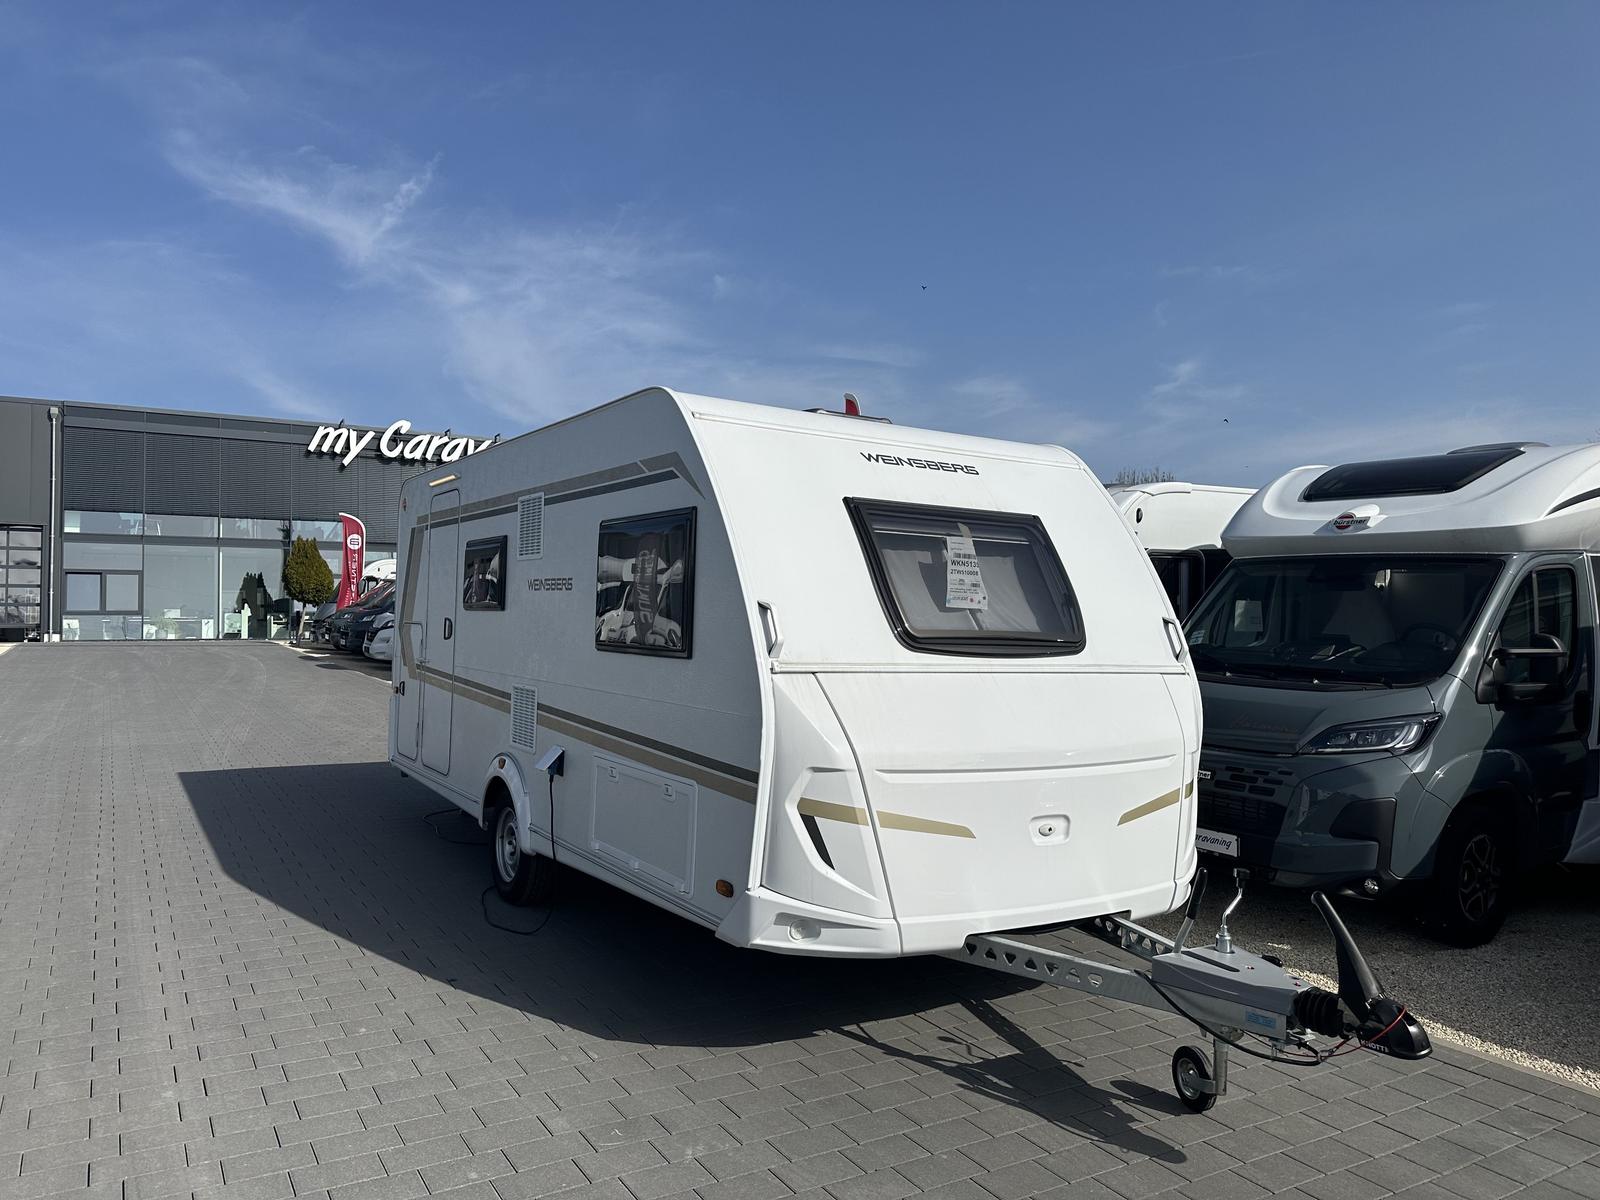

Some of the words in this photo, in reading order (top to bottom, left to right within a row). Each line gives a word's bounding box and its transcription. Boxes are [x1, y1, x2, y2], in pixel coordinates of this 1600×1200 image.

[307, 425, 376, 467] my
[379, 419, 501, 462] Carav
[859, 451, 980, 476] WEINSBERG
[527, 577, 573, 591] WEINSBERG
[1195, 834, 1233, 850] ravaning
